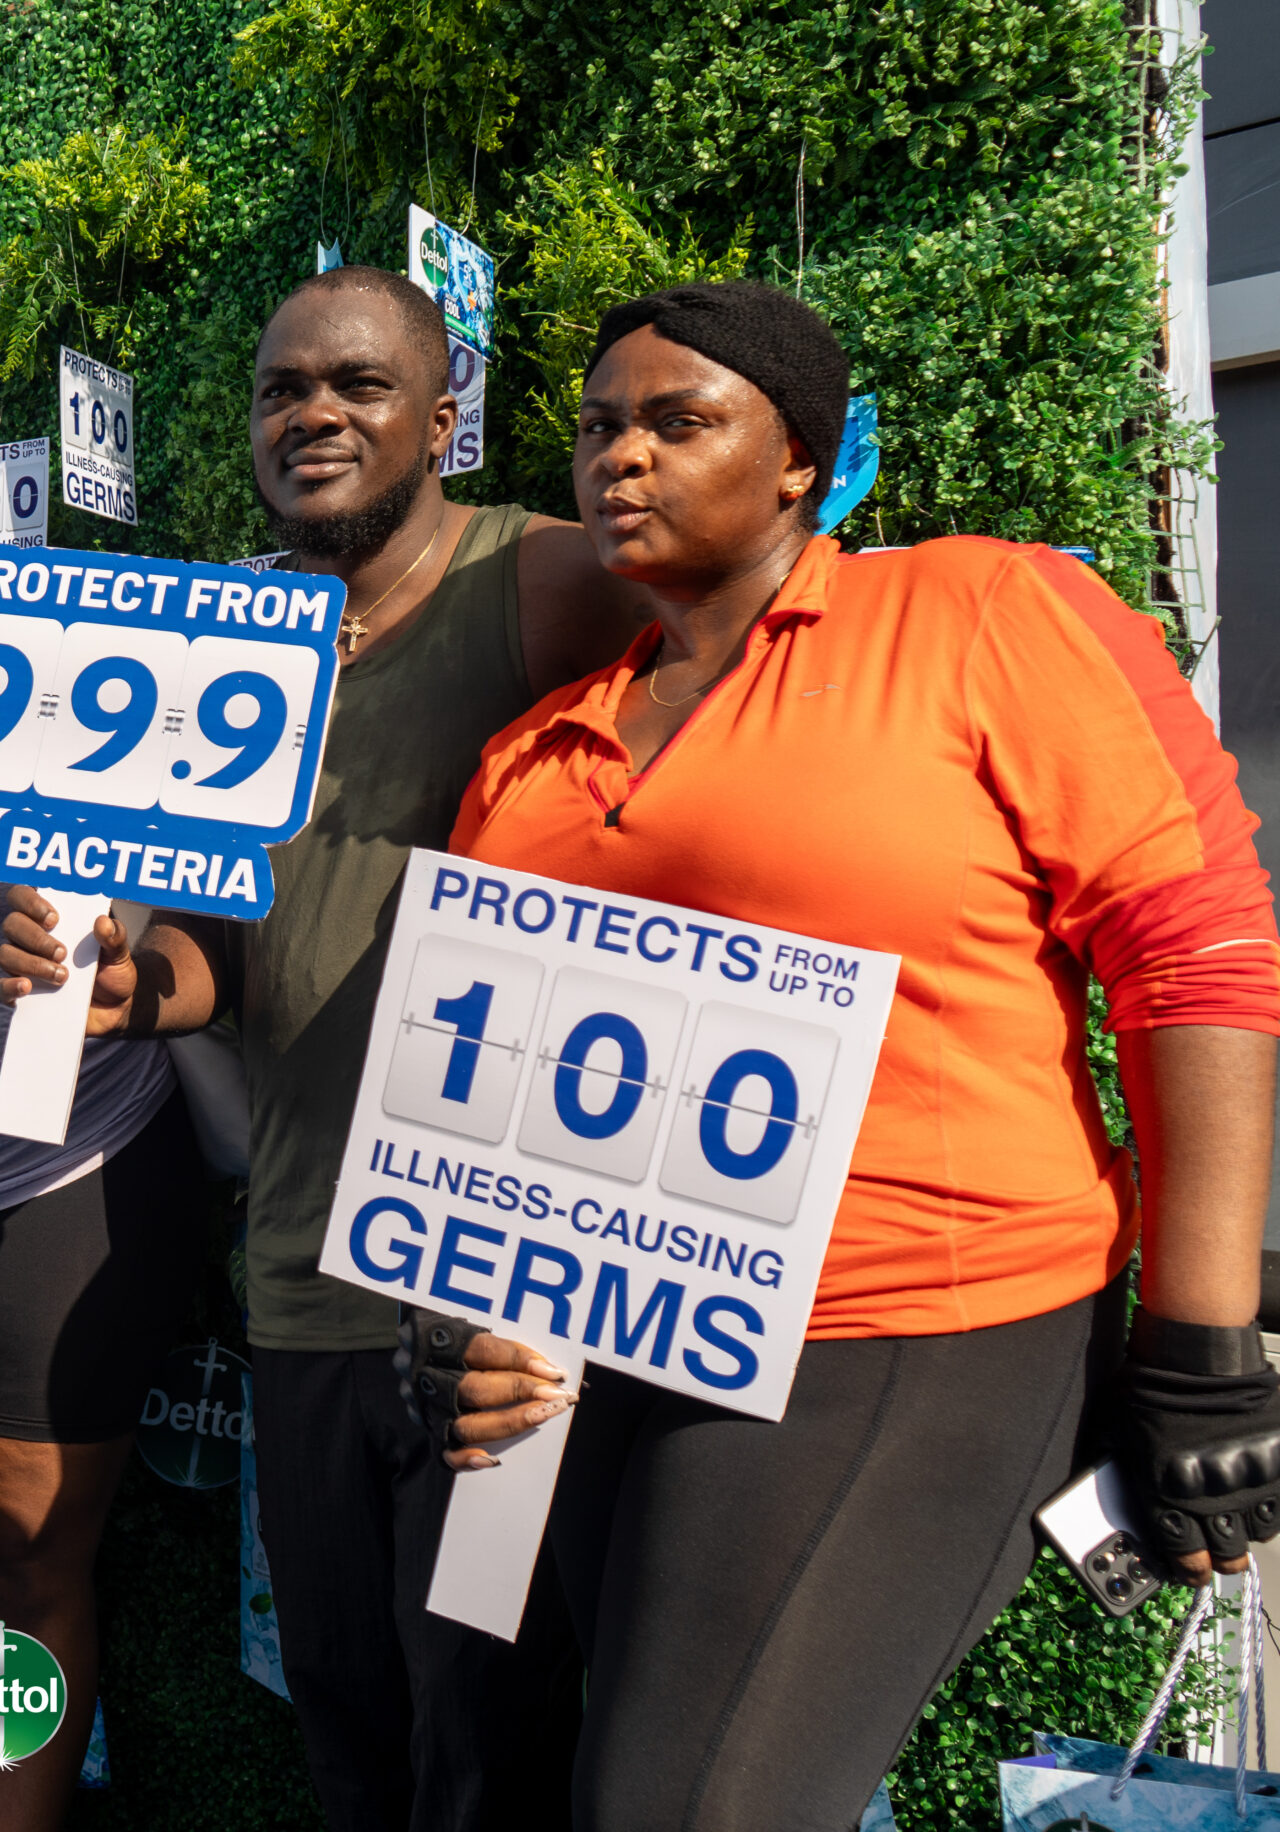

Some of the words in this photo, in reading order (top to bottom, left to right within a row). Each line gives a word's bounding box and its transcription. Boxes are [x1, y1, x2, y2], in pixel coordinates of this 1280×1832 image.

[421, 242, 448, 273] Dettol
[64, 351, 117, 390] PROTECTS
[23, 440, 45, 449] FROM
[70, 392, 127, 453] 100
[23, 450, 33, 458] UP
[36, 448, 46, 456] TO
[66, 451, 133, 487] ILLNESS-CAUSING
[66, 472, 135, 521] GERMS
[185, 578, 329, 632] FROM
[5, 825, 258, 903] BACTERIA
[430, 868, 762, 983] PROTECTS
[773, 944, 861, 981] FROM
[768, 963, 809, 996] UP
[818, 980, 855, 1008] TO
[432, 980, 799, 1180] 100
[369, 1139, 784, 1289] ILLNESS-CAUSING
[348, 1195, 765, 1390] GERMS
[139, 1388, 245, 1441] Detto
